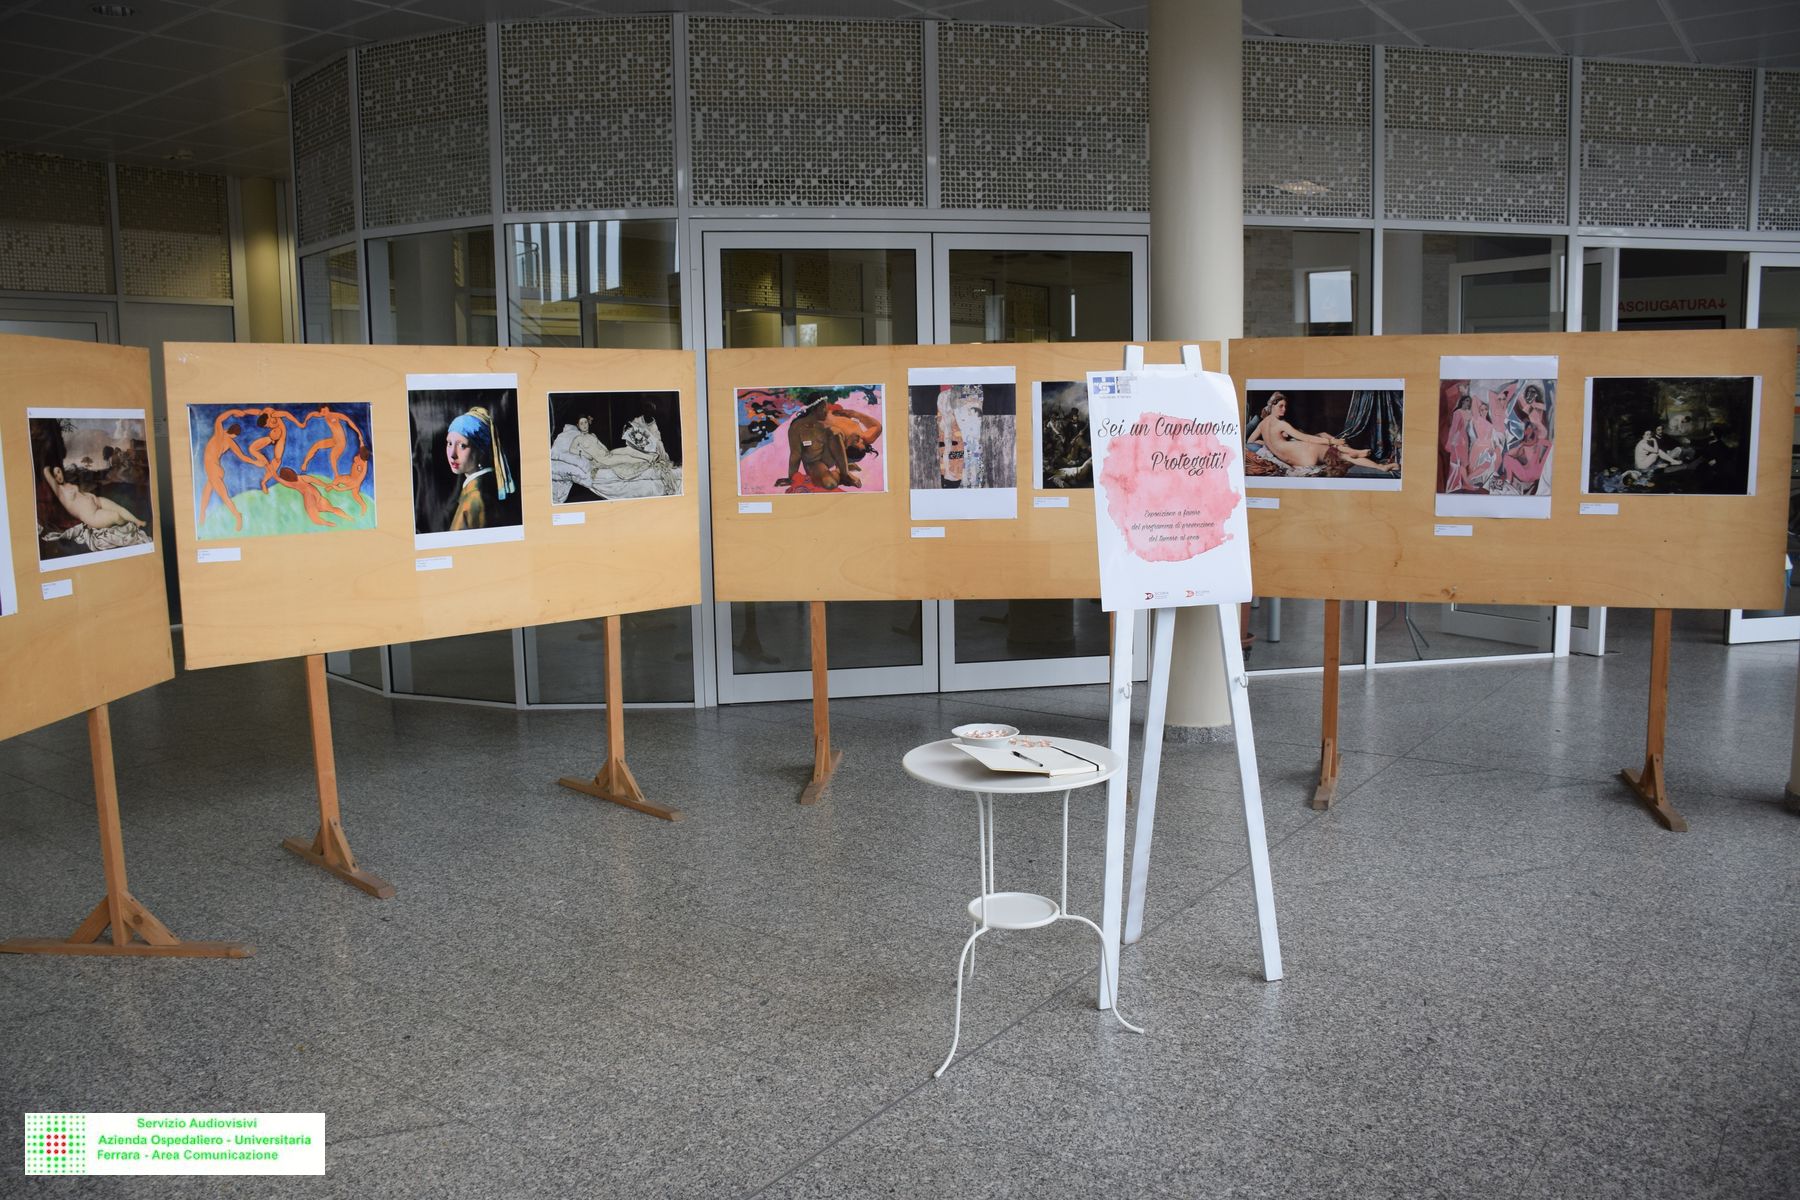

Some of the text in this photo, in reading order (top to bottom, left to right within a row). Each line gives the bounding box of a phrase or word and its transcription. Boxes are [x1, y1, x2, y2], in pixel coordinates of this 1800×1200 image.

[1098, 416, 1239, 440] Sei un Capolavoro:
[1151, 451, 1227, 476] Proteggiti!
